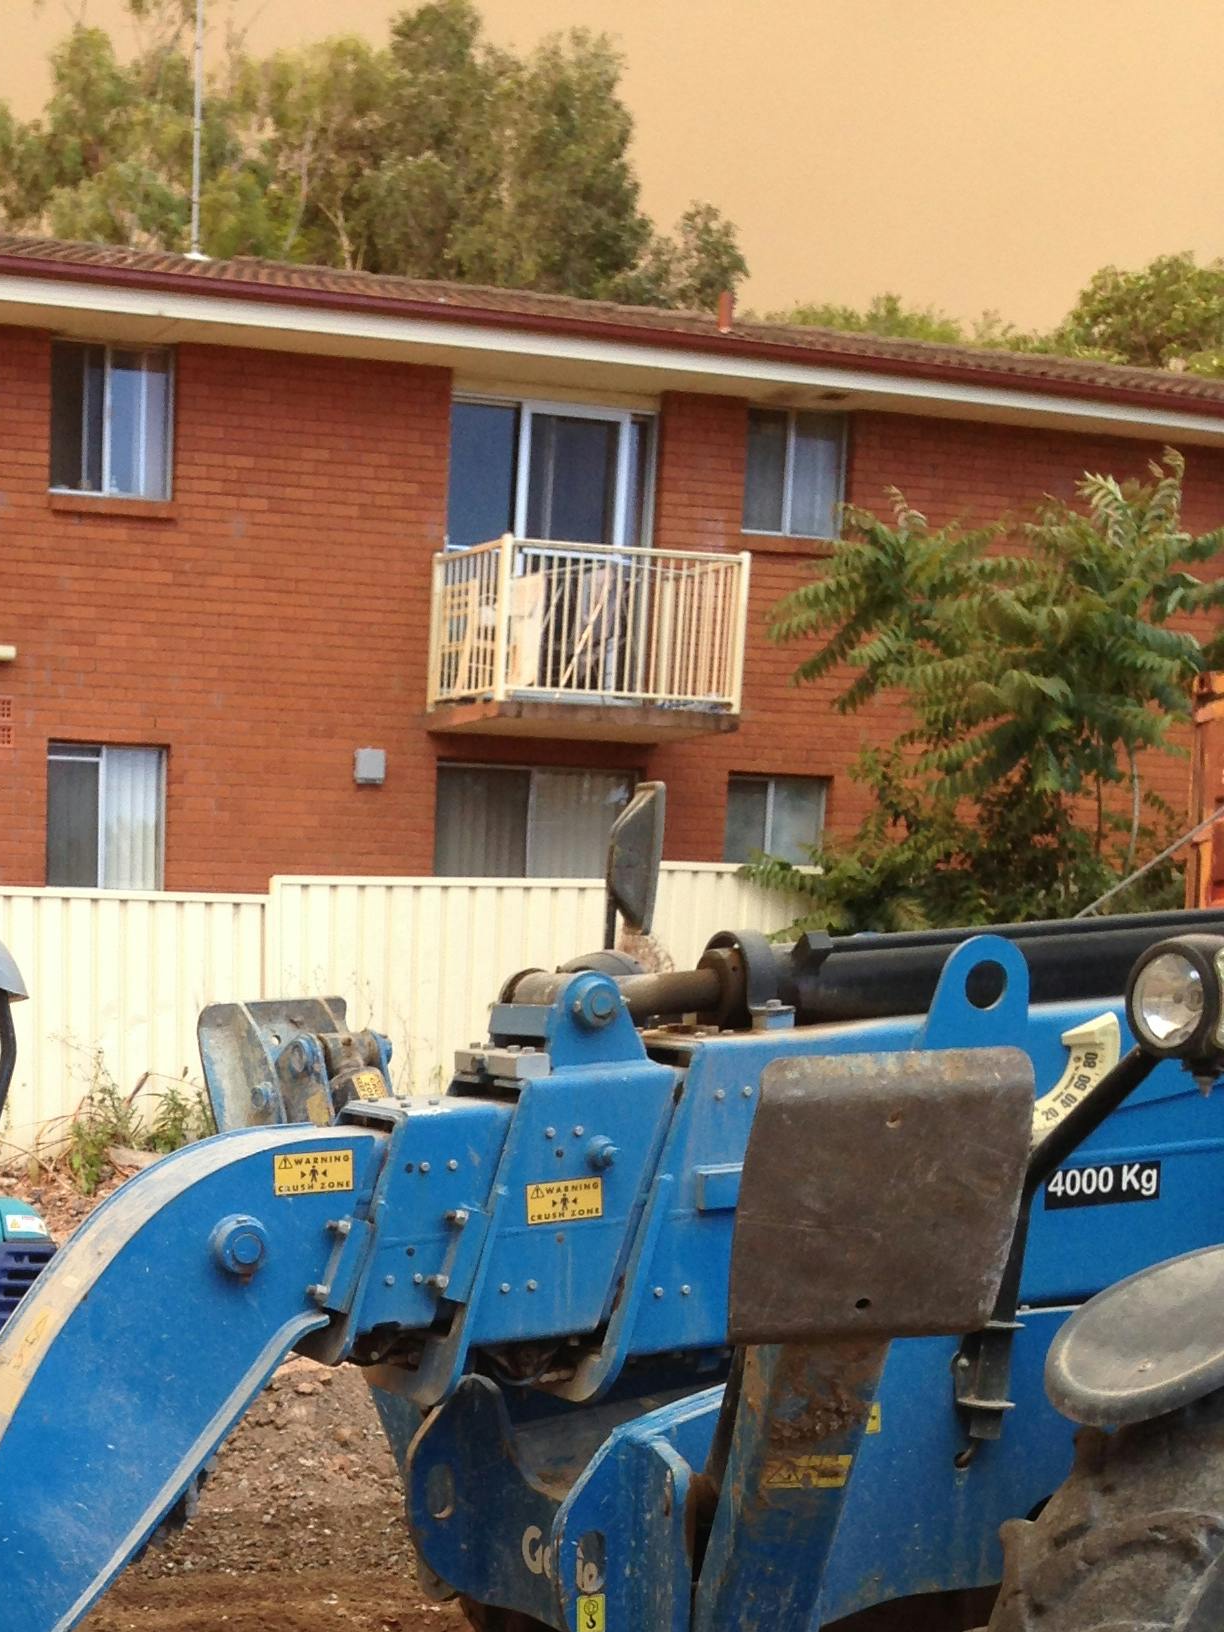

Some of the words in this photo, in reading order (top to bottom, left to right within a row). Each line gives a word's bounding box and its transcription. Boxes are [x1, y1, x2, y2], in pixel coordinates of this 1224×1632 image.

[1041, 1107, 1059, 1121] 20
[1060, 1093, 1077, 1109] 40
[1074, 1074, 1091, 1091] 60
[294, 1154, 350, 1166] WARNING
[278, 1183, 314, 1192] CRUSH
[320, 1181, 350, 1190] ZONE
[1047, 1166, 1114, 1197] 4000
[1121, 1163, 1158, 1196] Kg
[545, 1182, 599, 1194] WARNING
[530, 1212, 565, 1222] CRUSH
[571, 1207, 600, 1217] ZONE
